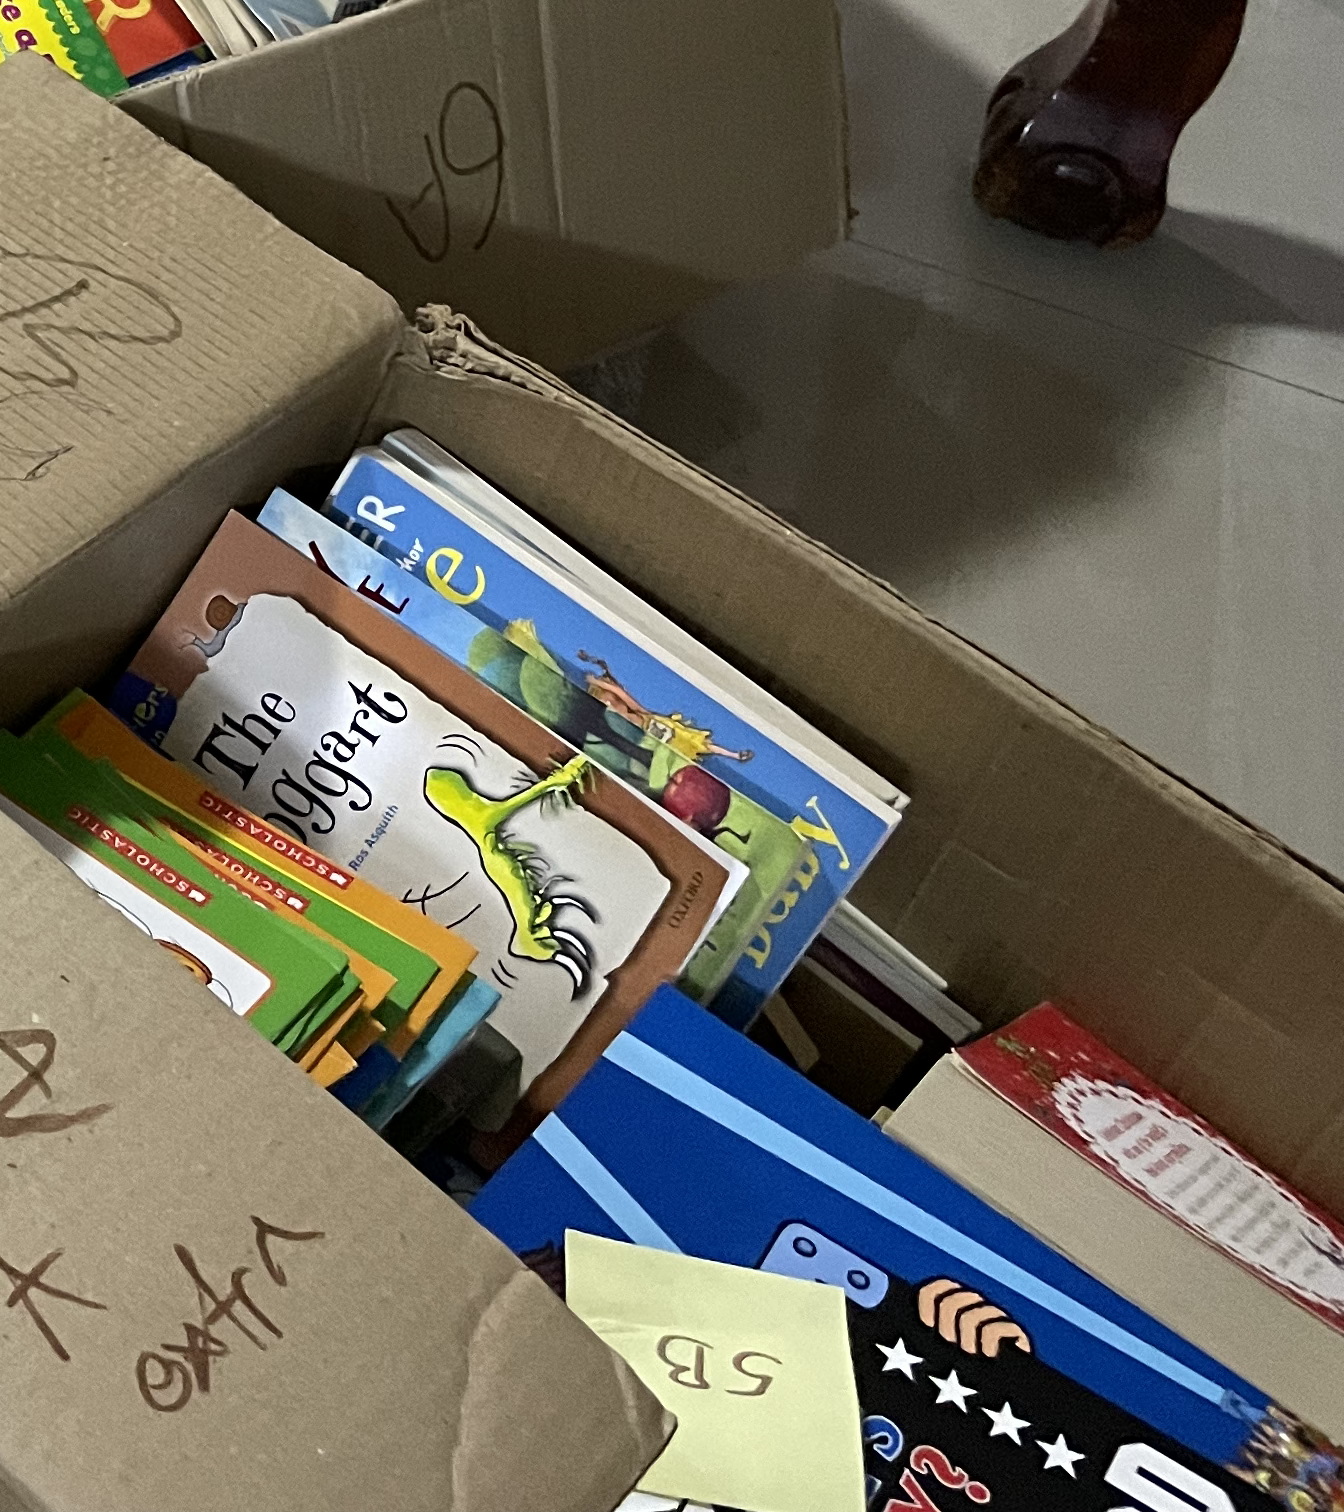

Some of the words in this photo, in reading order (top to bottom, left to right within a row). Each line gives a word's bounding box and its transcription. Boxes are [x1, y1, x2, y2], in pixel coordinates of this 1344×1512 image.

[192, 691, 297, 792] The
[68, 807, 190, 894] SCHOLASTIC
[200, 794, 330, 876] SCHOLASTIC
[348, 846, 370, 872] Ros
[367, 803, 400, 847] Asquith
[668, 870, 704, 930] OXFORD
[655, 1334, 784, 1398] 5B
